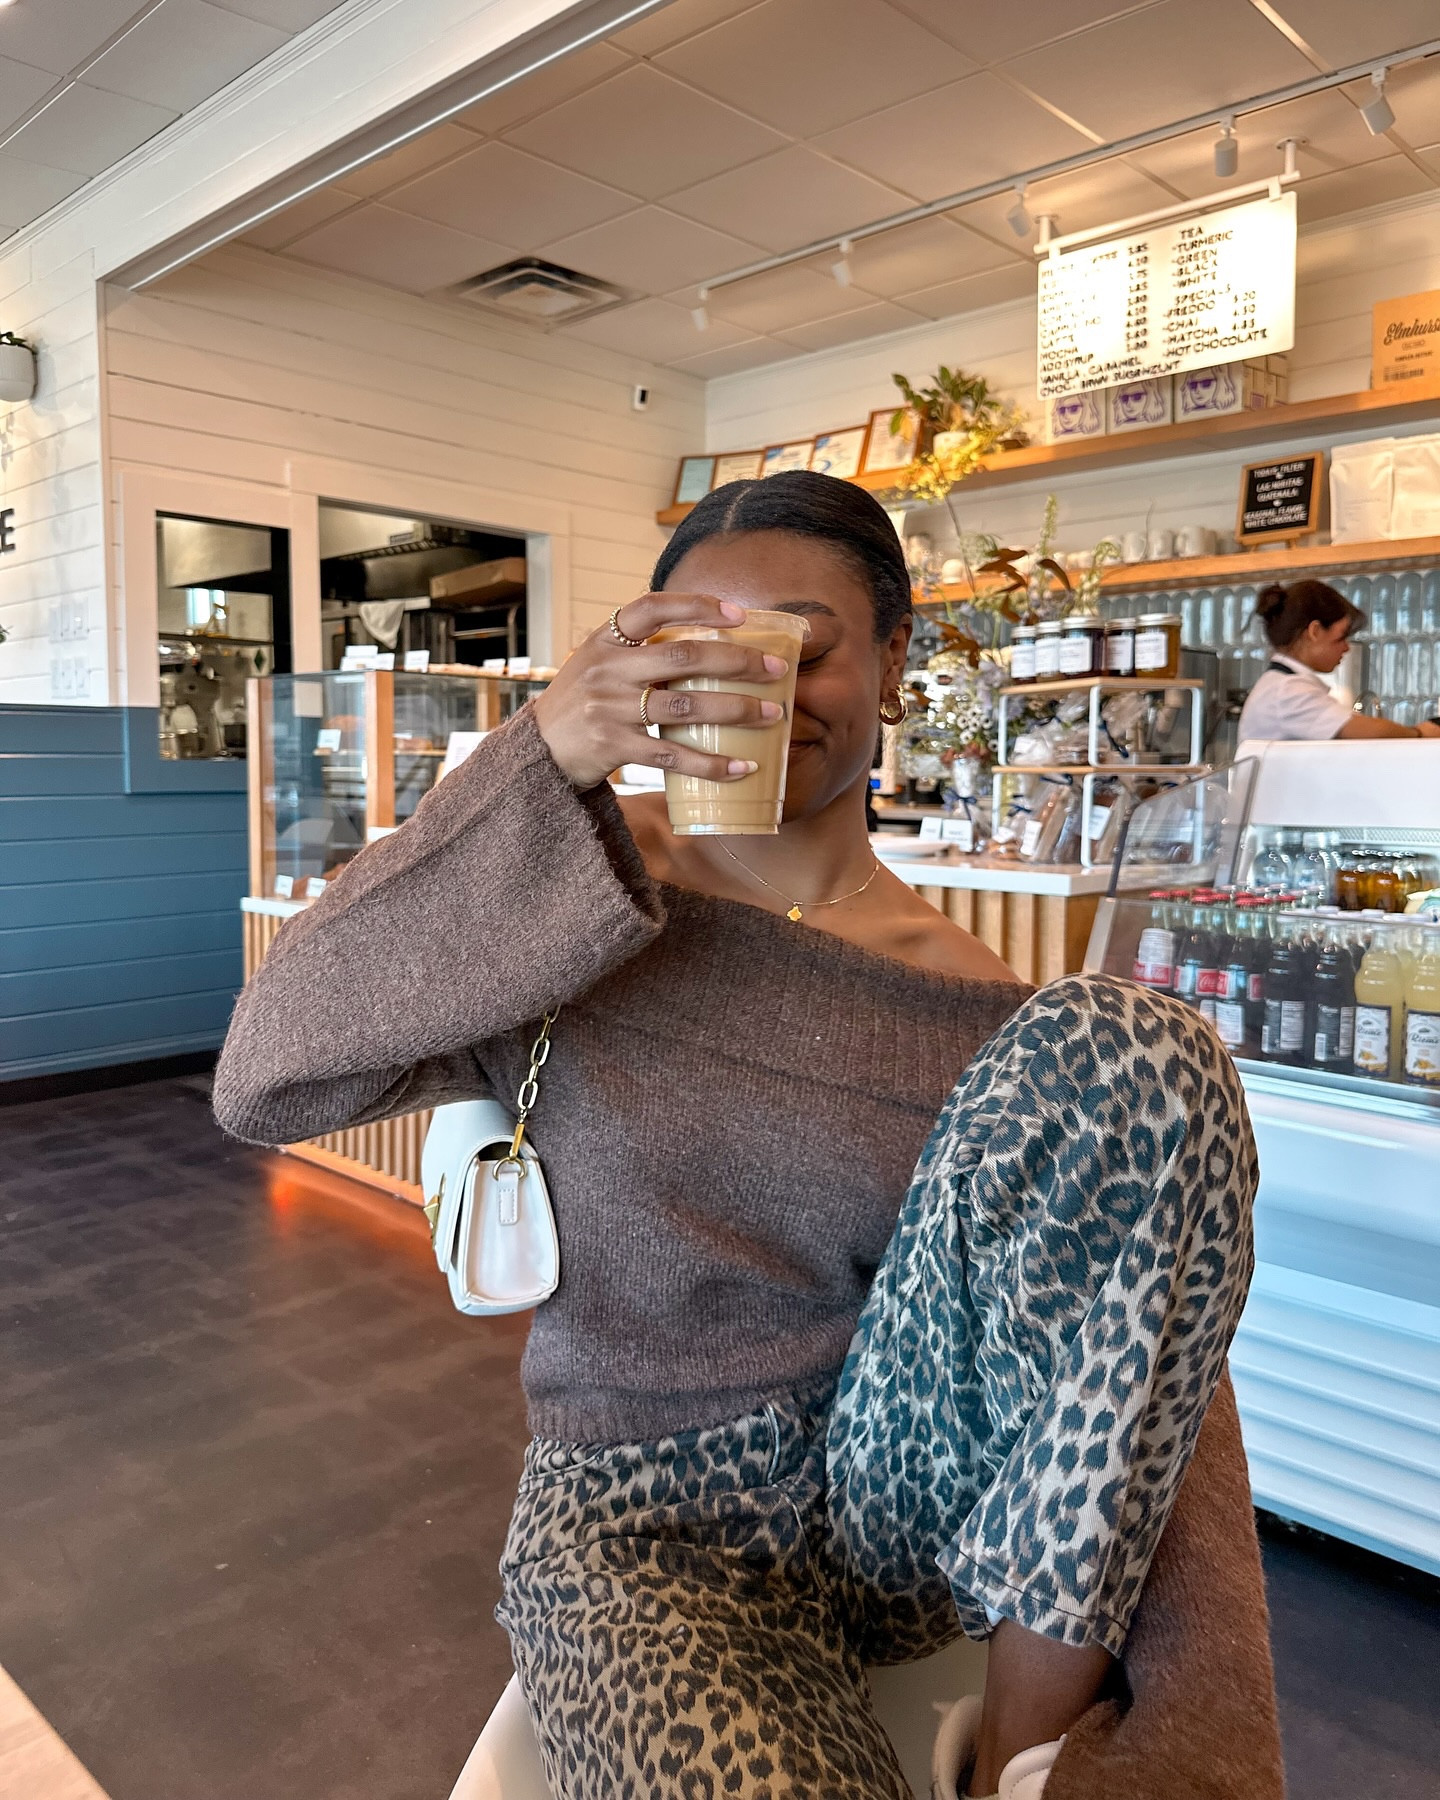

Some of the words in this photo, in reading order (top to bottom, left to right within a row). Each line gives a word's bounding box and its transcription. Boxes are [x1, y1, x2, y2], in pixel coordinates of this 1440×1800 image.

[1180, 226, 1204, 240] TEA
[1193, 328, 1268, 353] CHOCOLATE
[1040, 346, 1079, 361] MOCHA
